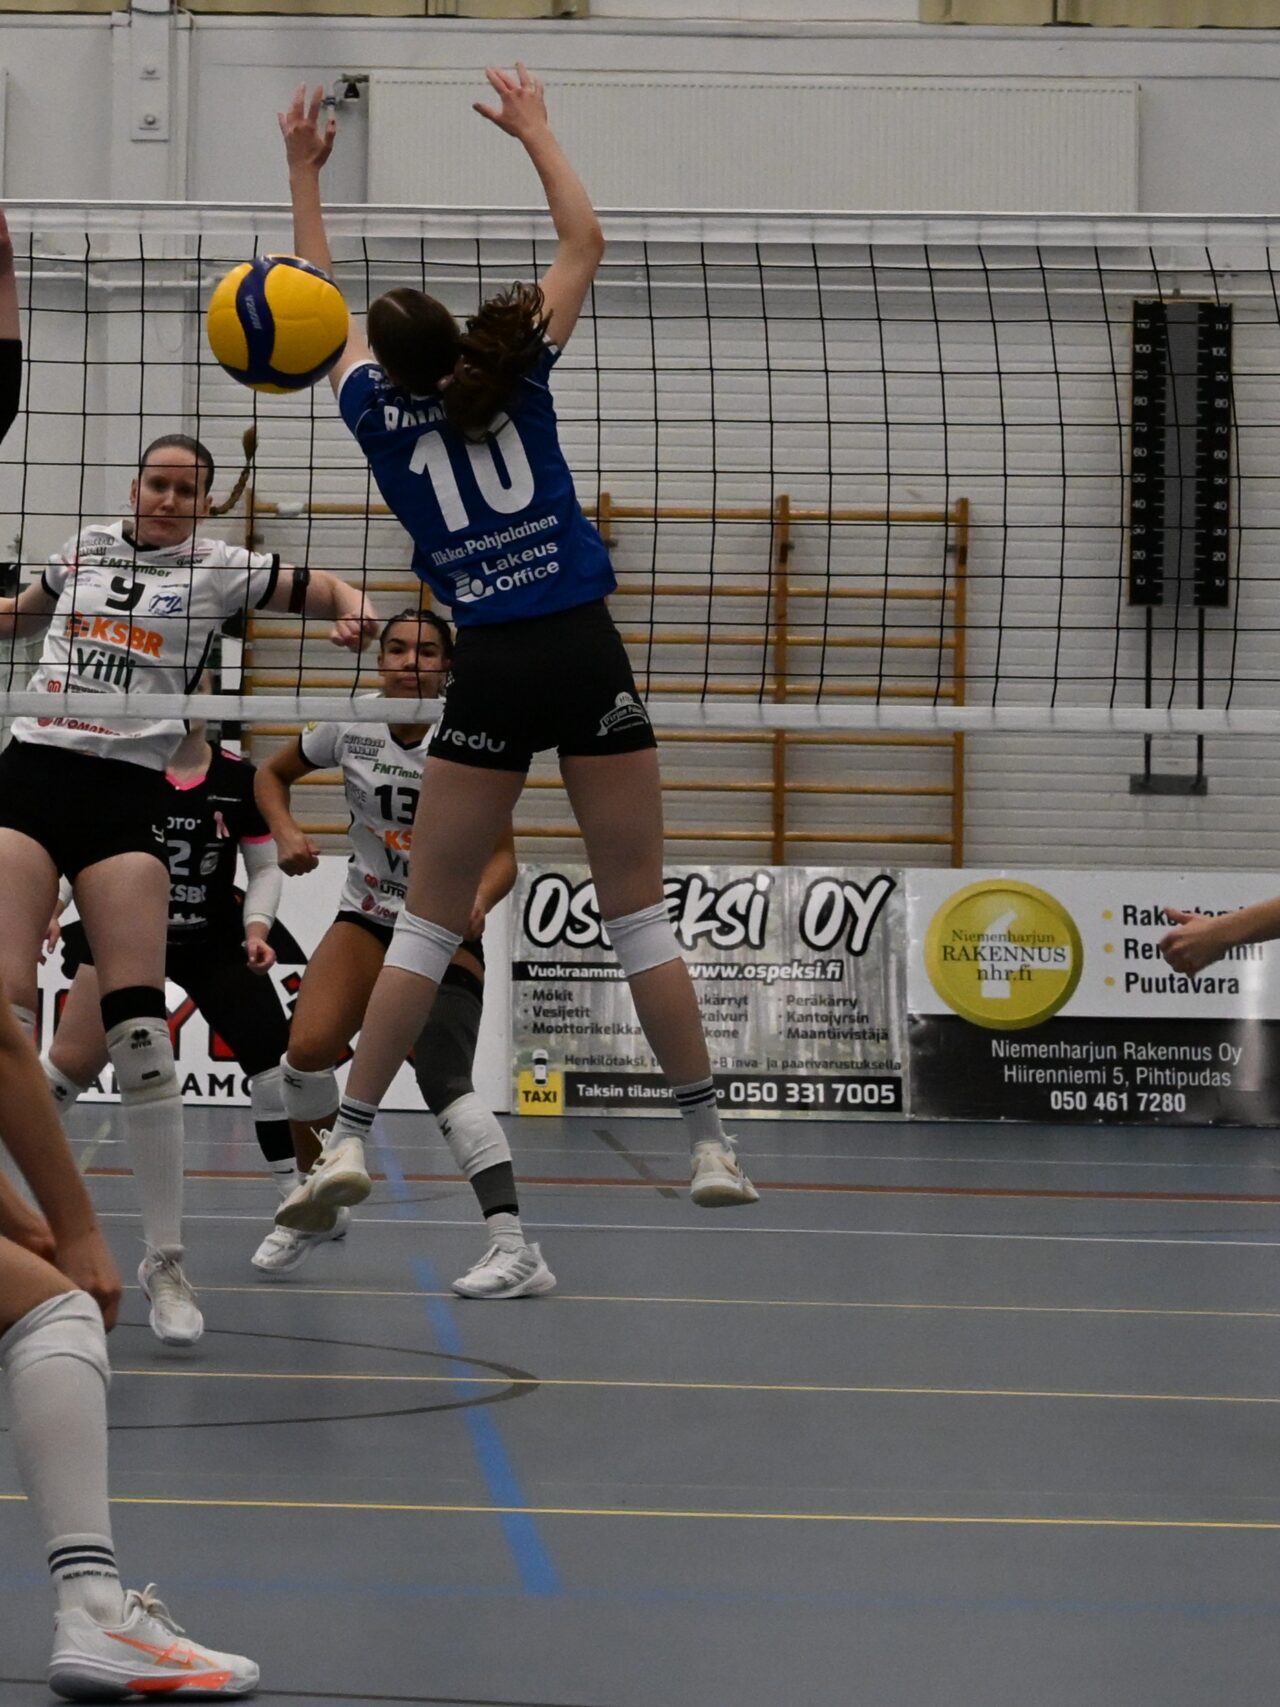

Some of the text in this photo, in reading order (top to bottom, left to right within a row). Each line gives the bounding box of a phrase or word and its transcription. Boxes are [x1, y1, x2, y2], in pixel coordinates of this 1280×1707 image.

[409, 411, 535, 532] 10
[481, 541, 558, 575] Lakeus
[496, 561, 559, 591] Office
[105, 575, 146, 612] 9
[90, 616, 164, 657] KSBR
[77, 647, 136, 689] Villi
[442, 728, 506, 753] sedu
[374, 784, 420, 826] 13
[798, 874, 898, 957] OY
[942, 944, 1067, 963] RAKENNUS
[528, 965, 626, 979] Vuokraamme
[977, 963, 1033, 982] nhr.fi
[1125, 971, 1240, 995] Puutavara
[786, 994, 858, 1009] Peräkärry
[786, 1011, 870, 1026] Kantojyrsin
[991, 1040, 1243, 1066] Niemenharjun Rakennus Oy
[1003, 1065, 1232, 1089] Hiirenniemi 5, Pihtipudas
[522, 1090, 558, 1103] TAXI
[576, 1084, 623, 1097] Taksin
[729, 1082, 779, 1103] 050
[785, 1083, 825, 1104] 331
[831, 1084, 896, 1105] 7005
[1050, 1090, 1187, 1113] 050 461 7280
